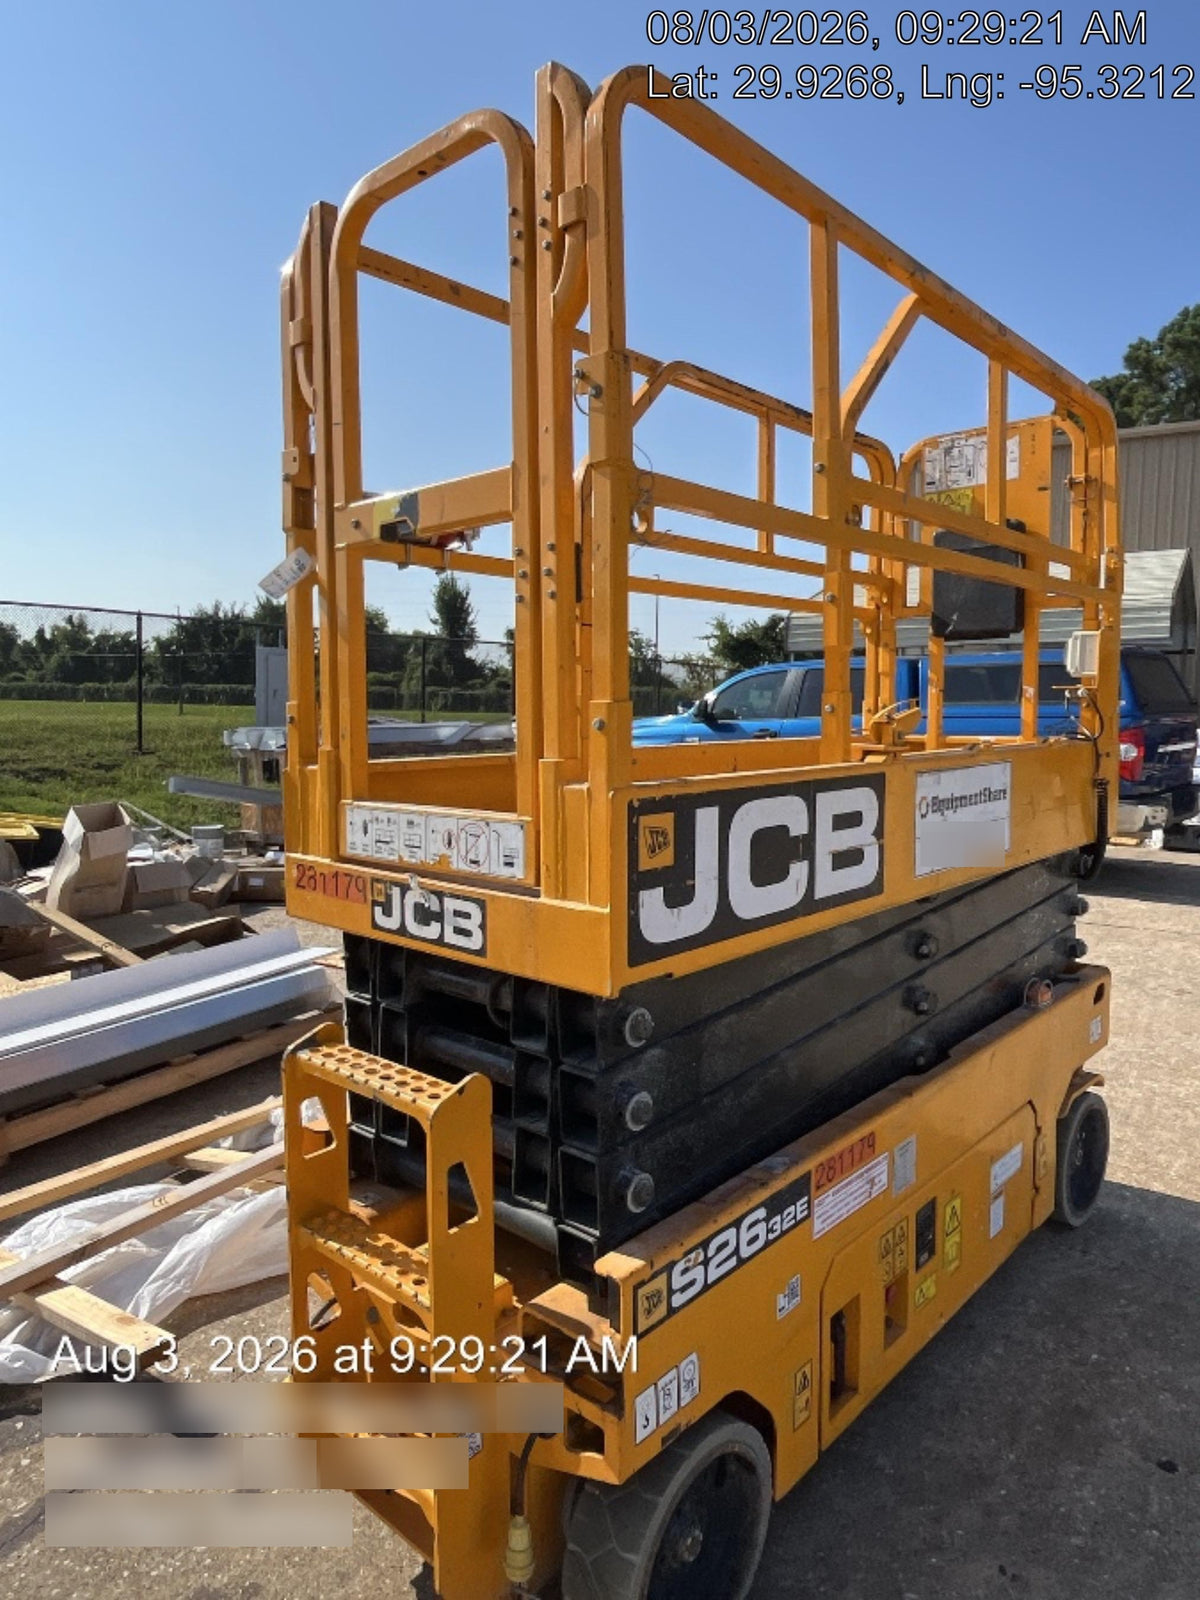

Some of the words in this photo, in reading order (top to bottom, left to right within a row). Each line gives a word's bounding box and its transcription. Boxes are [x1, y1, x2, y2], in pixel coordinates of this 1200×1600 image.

[638, 787, 880, 944] JCB
[372, 886, 484, 951] JCB
[815, 1131, 876, 1190] 281179
